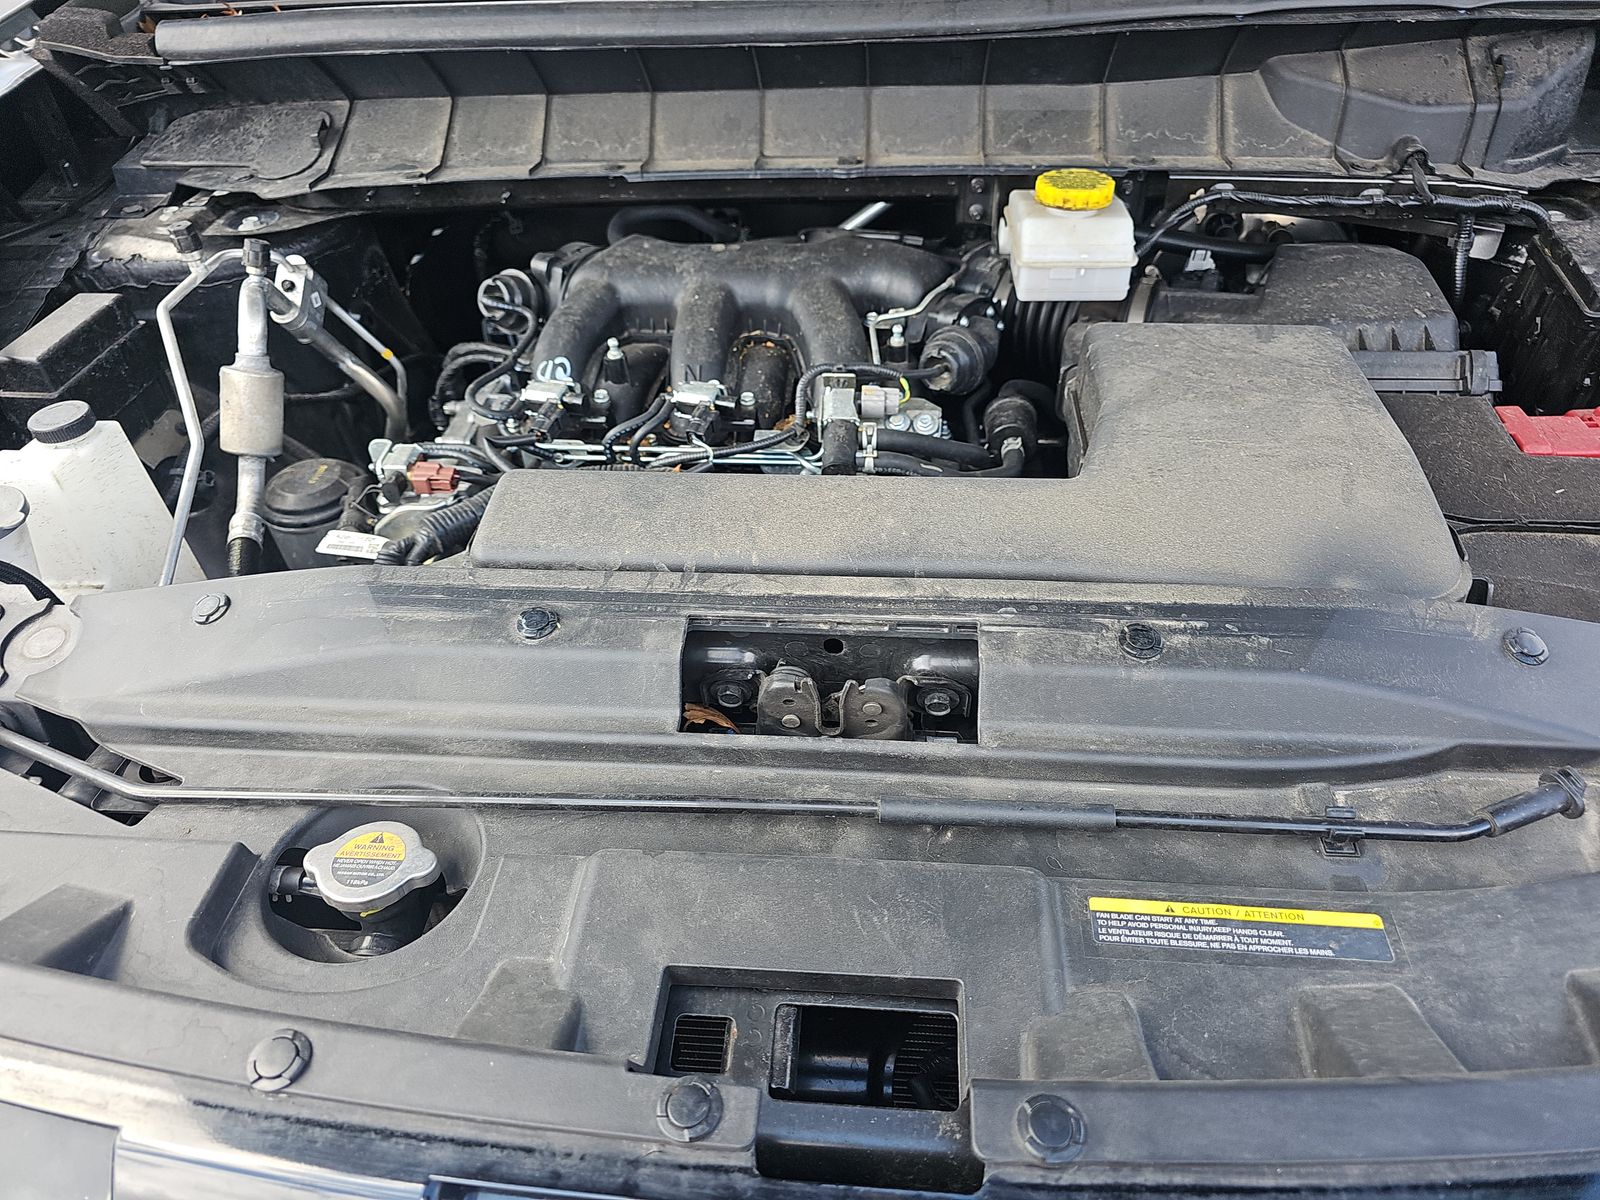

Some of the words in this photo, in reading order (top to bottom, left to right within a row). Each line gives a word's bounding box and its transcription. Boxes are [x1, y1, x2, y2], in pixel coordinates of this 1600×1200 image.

[340, 850, 402, 858] AVERTISSEMENT
[353, 843, 395, 851] WARNING
[1182, 906, 1231, 916] CAUTION
[1244, 910, 1305, 920] ATTENTION
[1150, 922, 1188, 930] PERSONAL
[1259, 929, 1285, 937] CLEAR.
[1107, 928, 1153, 937] VENTILATEUR
[1153, 931, 1181, 939] RISQUE
[1193, 932, 1233, 942] DÉMARRER
[1260, 938, 1294, 946] MOMENT.
[1120, 935, 1145, 944] ÉVITER
[1145, 937, 1170, 945] TOUTE
[1170, 939, 1209, 948] BLESSURE,
[1221, 942, 1236, 950] PAS
[1248, 945, 1294, 954] APPROCHER
[1294, 947, 1309, 955] LES
